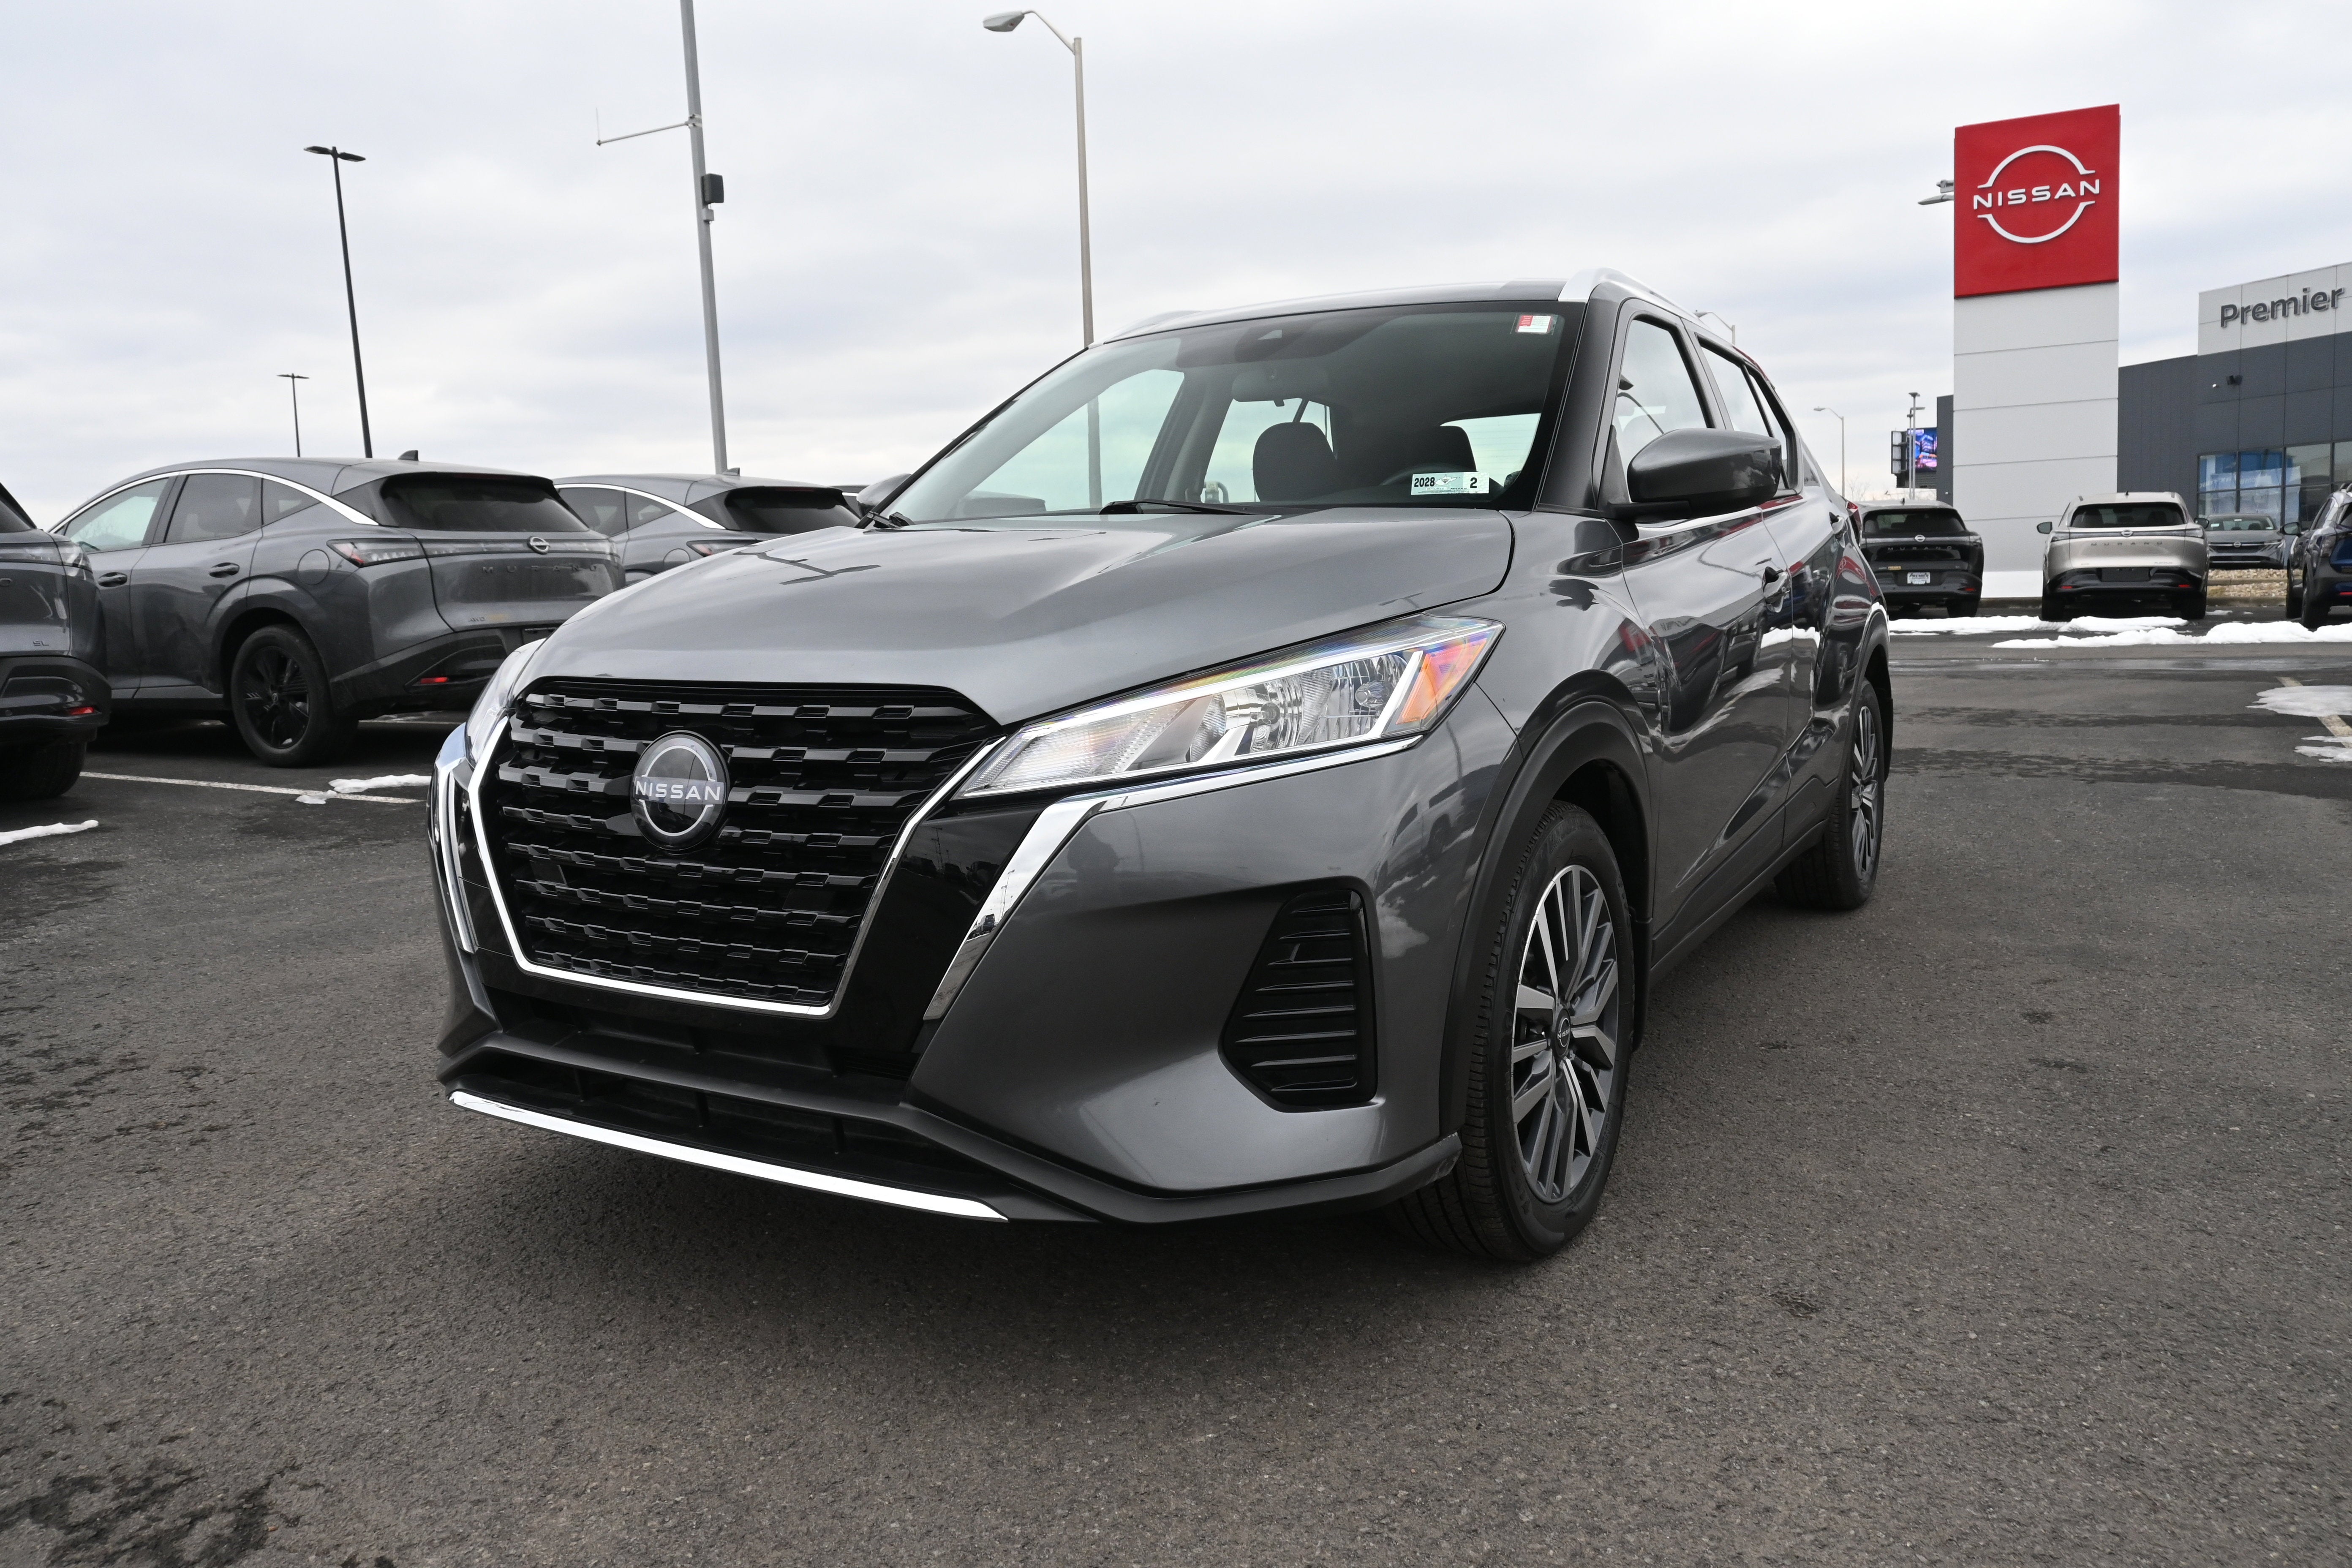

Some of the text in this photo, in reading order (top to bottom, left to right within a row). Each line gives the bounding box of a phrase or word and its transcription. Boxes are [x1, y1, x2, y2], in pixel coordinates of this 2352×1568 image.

[1974, 179, 2099, 210] NISSAN
[2221, 287, 2345, 328] Premier
[1414, 477, 1478, 488] 2028 2
[635, 781, 721, 800] NISSAN
